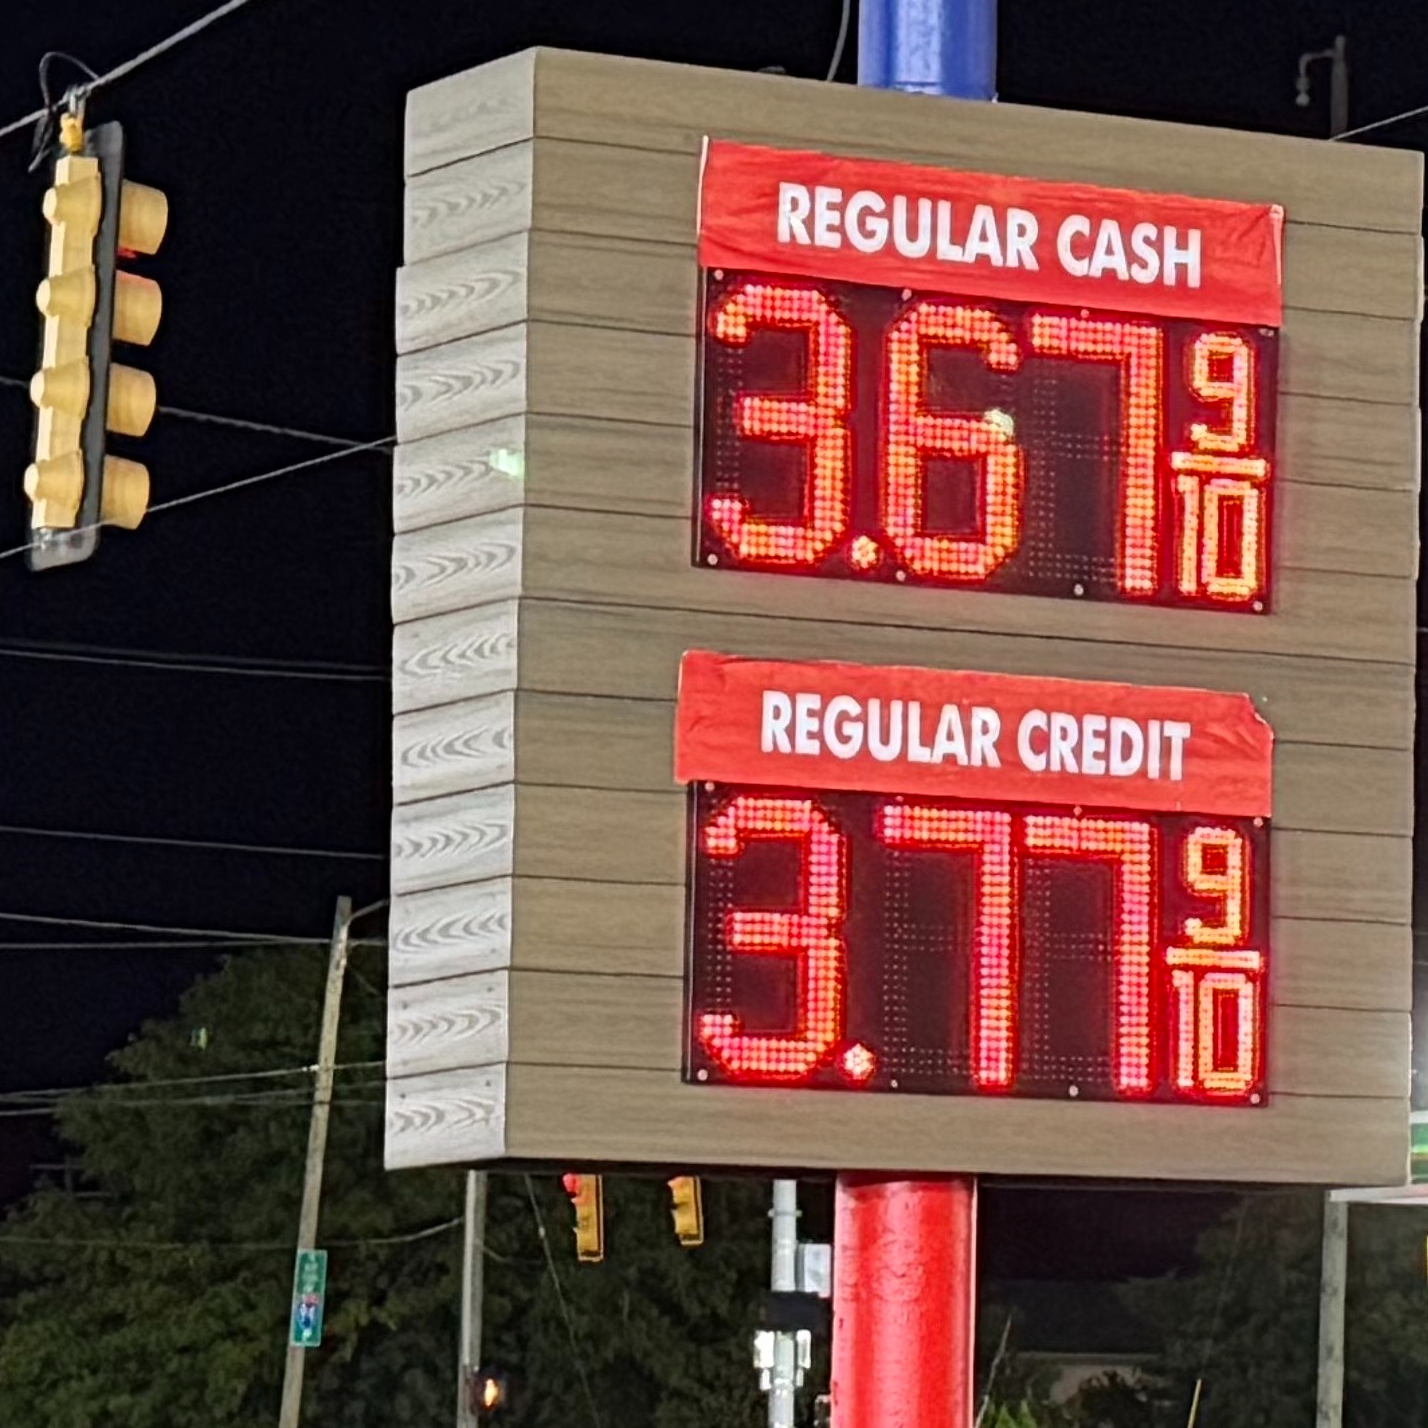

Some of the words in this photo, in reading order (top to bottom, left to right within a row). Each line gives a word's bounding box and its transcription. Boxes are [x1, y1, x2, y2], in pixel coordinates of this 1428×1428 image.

[777, 180, 1040, 271] REGULAR
[1056, 214, 1202, 289] CASH
[709, 282, 1164, 597] 3.67
[760, 689, 1002, 769] REGULAR
[1016, 708, 1192, 782] CREDIT
[698, 795, 1153, 1093] 3.77
